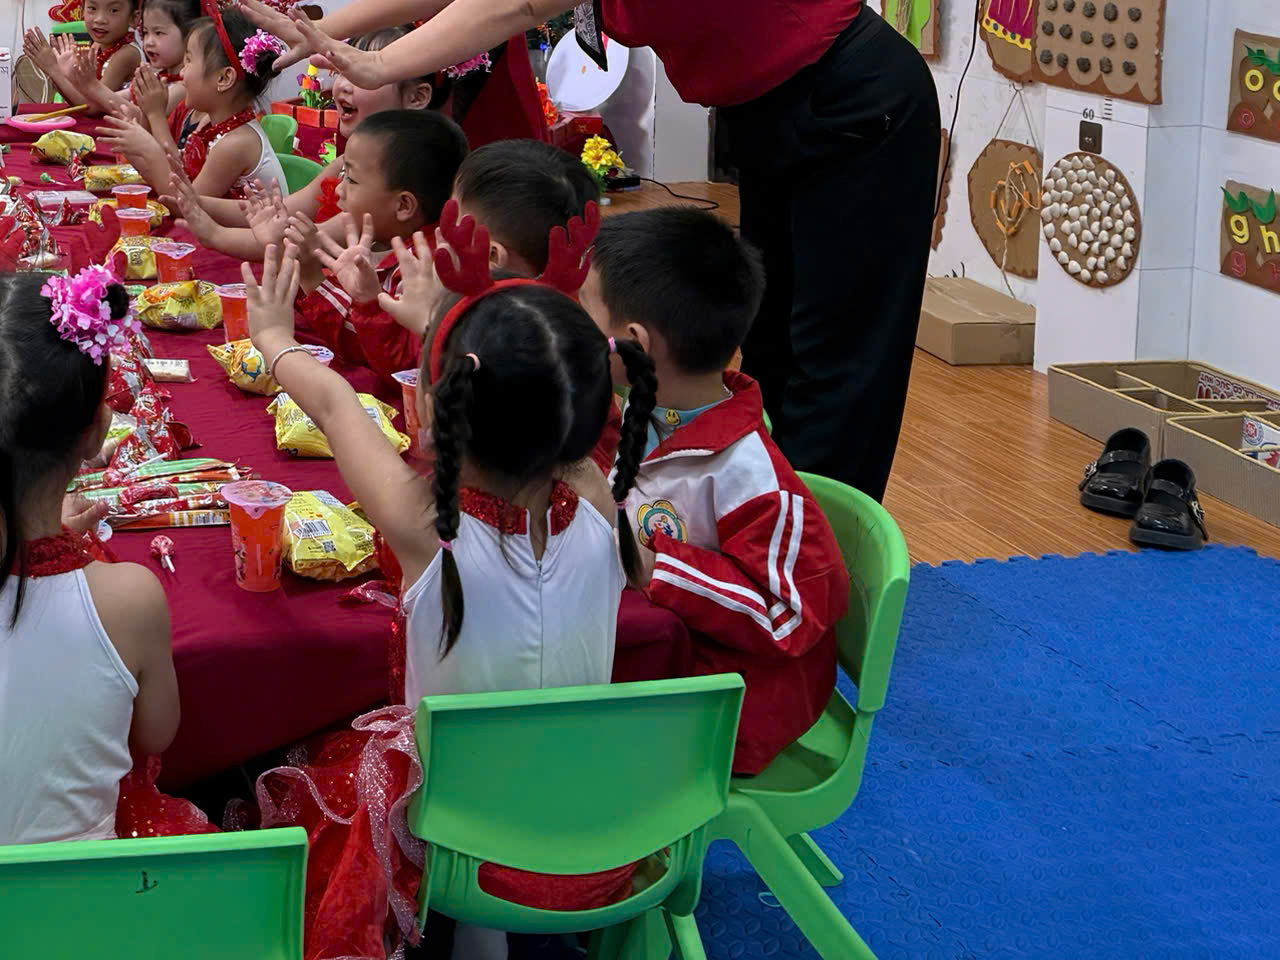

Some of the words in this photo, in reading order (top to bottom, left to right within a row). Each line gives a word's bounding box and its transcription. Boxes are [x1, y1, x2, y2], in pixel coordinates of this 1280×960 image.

[1082, 108, 1095, 120] 60
[1229, 214, 1250, 245] g
[1260, 226, 1280, 253] h
